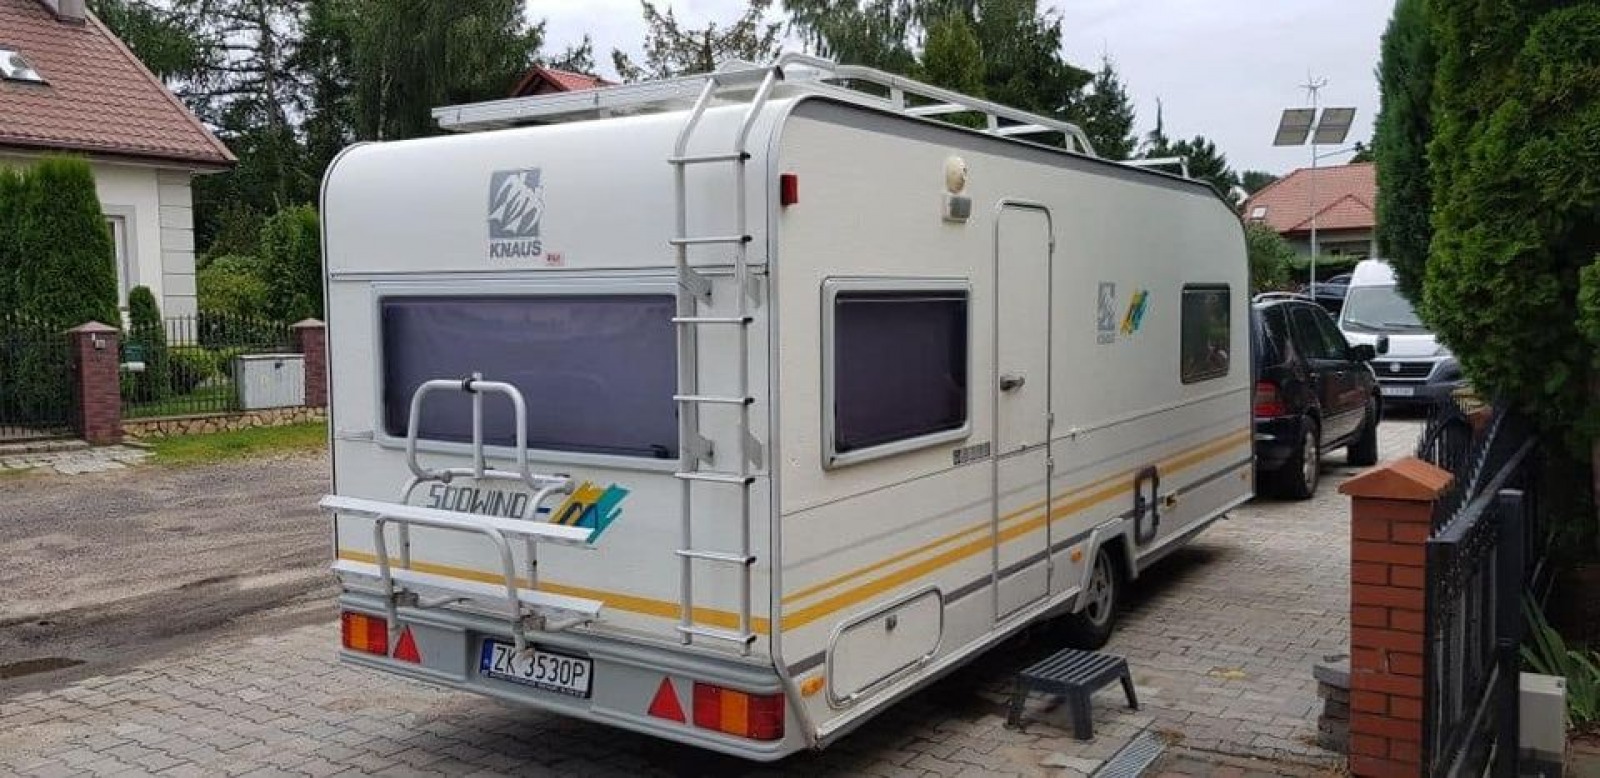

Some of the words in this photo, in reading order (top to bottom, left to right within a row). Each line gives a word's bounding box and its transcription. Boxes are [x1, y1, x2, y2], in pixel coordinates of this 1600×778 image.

[489, 240, 542, 259] KNAUS
[494, 647, 516, 674] ZK
[525, 655, 584, 686] 3530P
